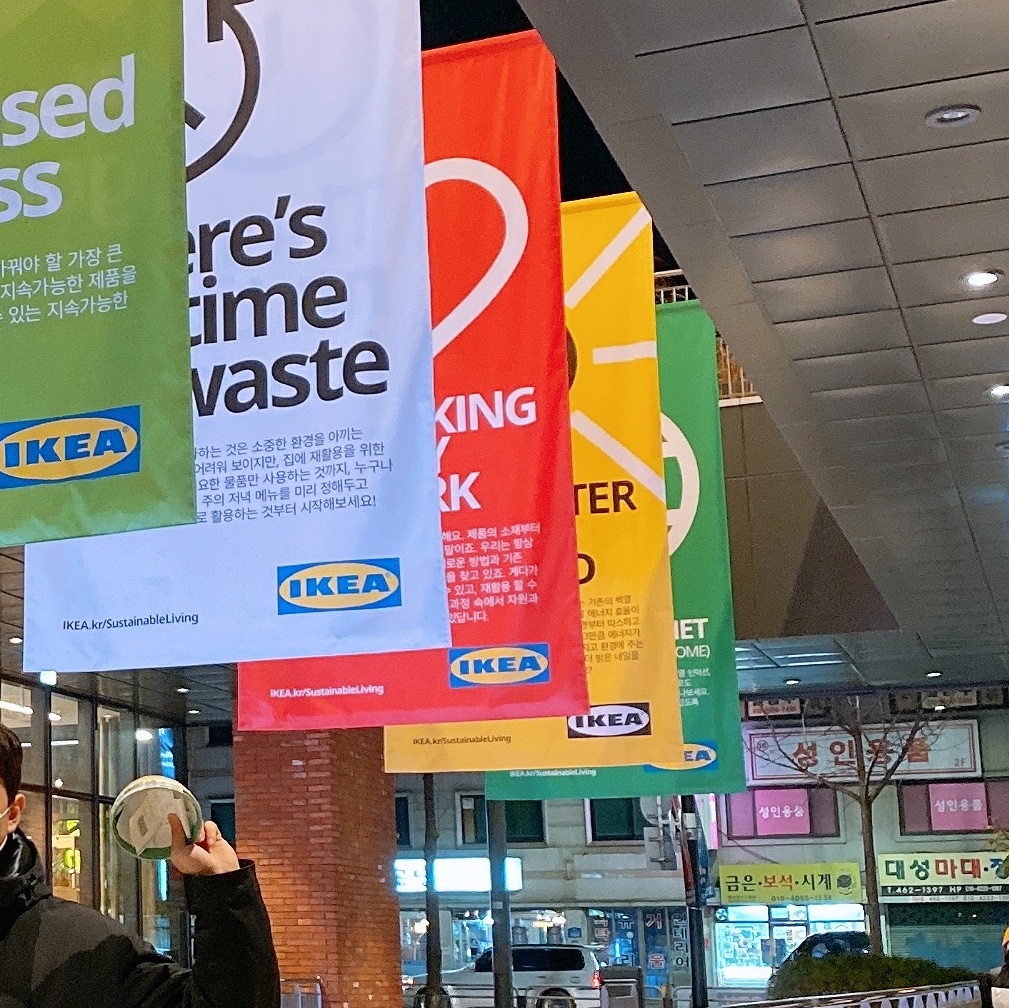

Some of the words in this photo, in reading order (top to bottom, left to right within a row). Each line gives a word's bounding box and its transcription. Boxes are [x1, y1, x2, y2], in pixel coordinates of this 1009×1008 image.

[45, 252, 62, 272] 할
[68, 247, 102, 269] 가장
[106, 243, 123, 264] 큰
[0, 273, 83, 301] 지속가능한
[88, 264, 137, 289] 제품을
[8, 304, 42, 325] 있는
[47, 290, 128, 319] 지속가능한
[4, 427, 129, 468] IKEA
[195, 446, 222, 459] 하는
[226, 442, 249, 457] 것은
[252, 438, 287, 454] 소중한
[291, 433, 325, 450] 환경을
[329, 427, 363, 443] 아끼는
[232, 456, 279, 471] 보이지만,
[283, 452, 306, 467] 집에
[310, 444, 355, 463] 재활용을
[359, 442, 385, 457] 위한
[224, 473, 259, 489] 물품만
[263, 468, 311, 485] 사용하는
[314, 461, 350, 479] 것까지,
[354, 458, 393, 473] 누구나
[229, 490, 251, 504] 저녁
[255, 486, 290, 502] 메뉴를
[294, 483, 317, 498] 미리
[320, 477, 368, 494] 정해두고
[211, 507, 258, 524] 활용하는
[262, 502, 297, 519] 것부터
[300, 495, 377, 513] 시작해보세요!
[467, 527, 498, 540] 제품의
[501, 522, 541, 537] 소재부터
[480, 540, 511, 552] 우리는
[513, 537, 534, 549] 항상
[443, 556, 466, 568] 로운
[469, 554, 500, 567] 방법과
[503, 552, 523, 564] 기존
[460, 570, 480, 582] 찾고
[509, 564, 539, 577] 게다가
[289, 573, 390, 599] IKEA
[480, 581, 511, 593] 재활용
[527, 579, 538, 590] 수
[473, 595, 505, 608] 속에서
[62, 612, 199, 631] IKEA.kr/SustainableLiving
[460, 656, 541, 675] IKEA
[270, 683, 385, 698] IKEA.kr/SustainableLiving
[574, 712, 644, 728] IKEA
[412, 734, 512, 746] IKEA.kr/SustainableLiving
